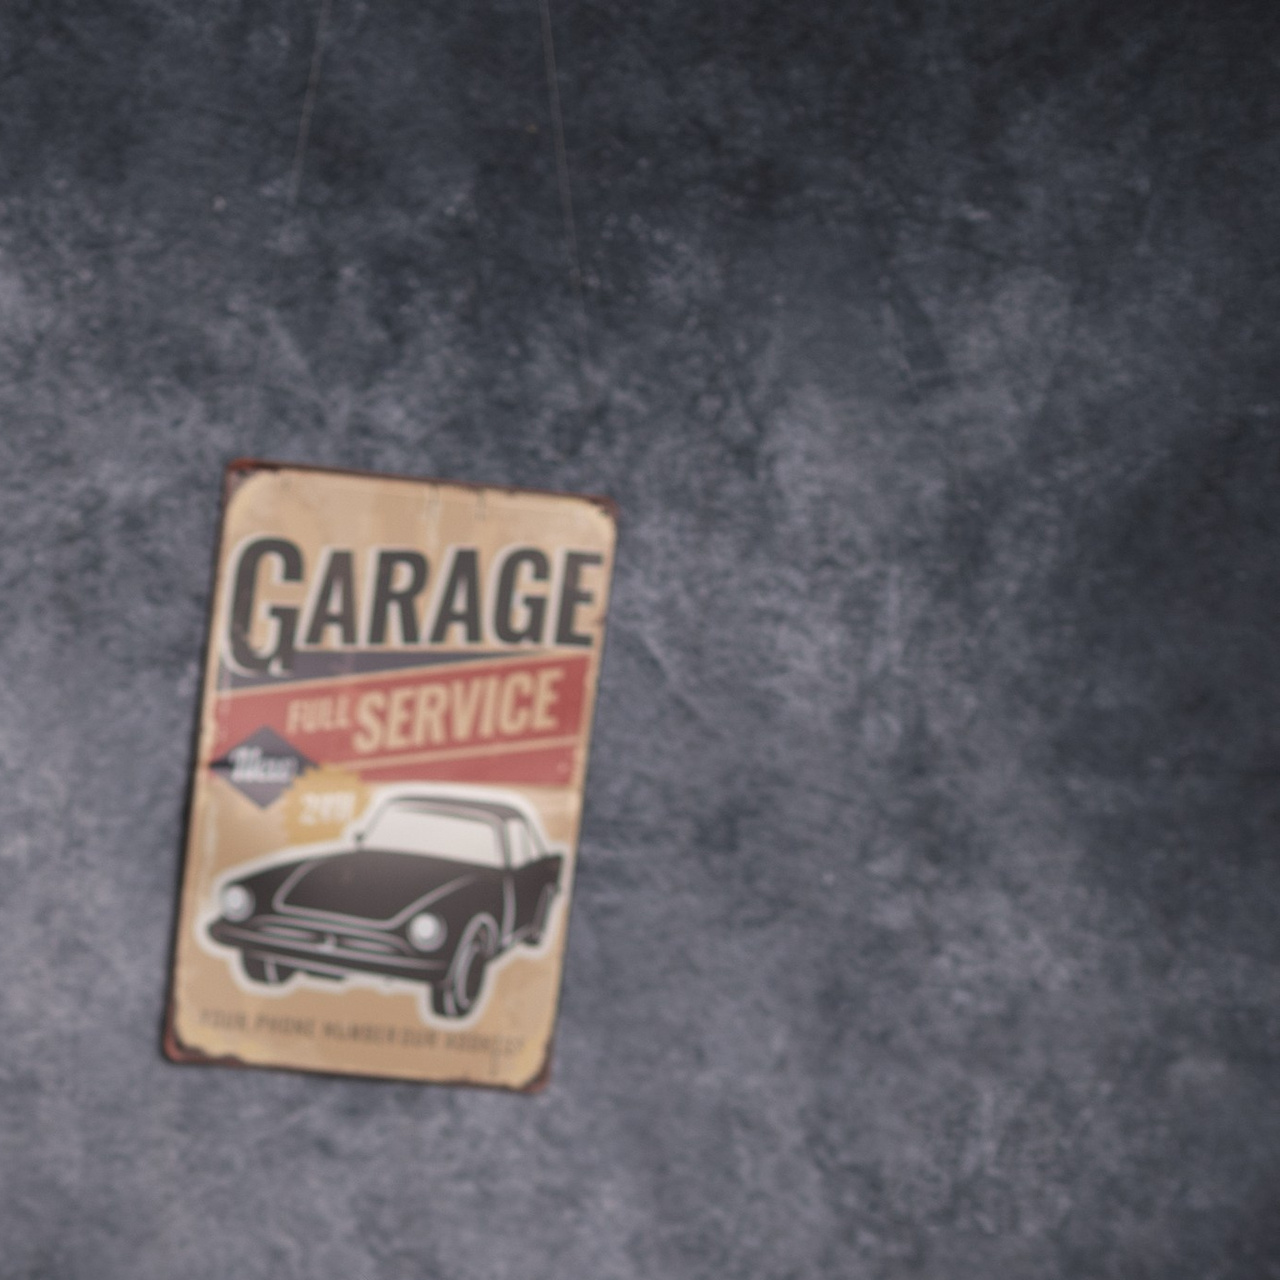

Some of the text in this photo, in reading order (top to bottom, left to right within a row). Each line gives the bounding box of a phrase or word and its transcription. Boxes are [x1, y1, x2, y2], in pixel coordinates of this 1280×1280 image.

[226, 535, 606, 675] GARAGE
[286, 667, 566, 754] FULL SERVICE
